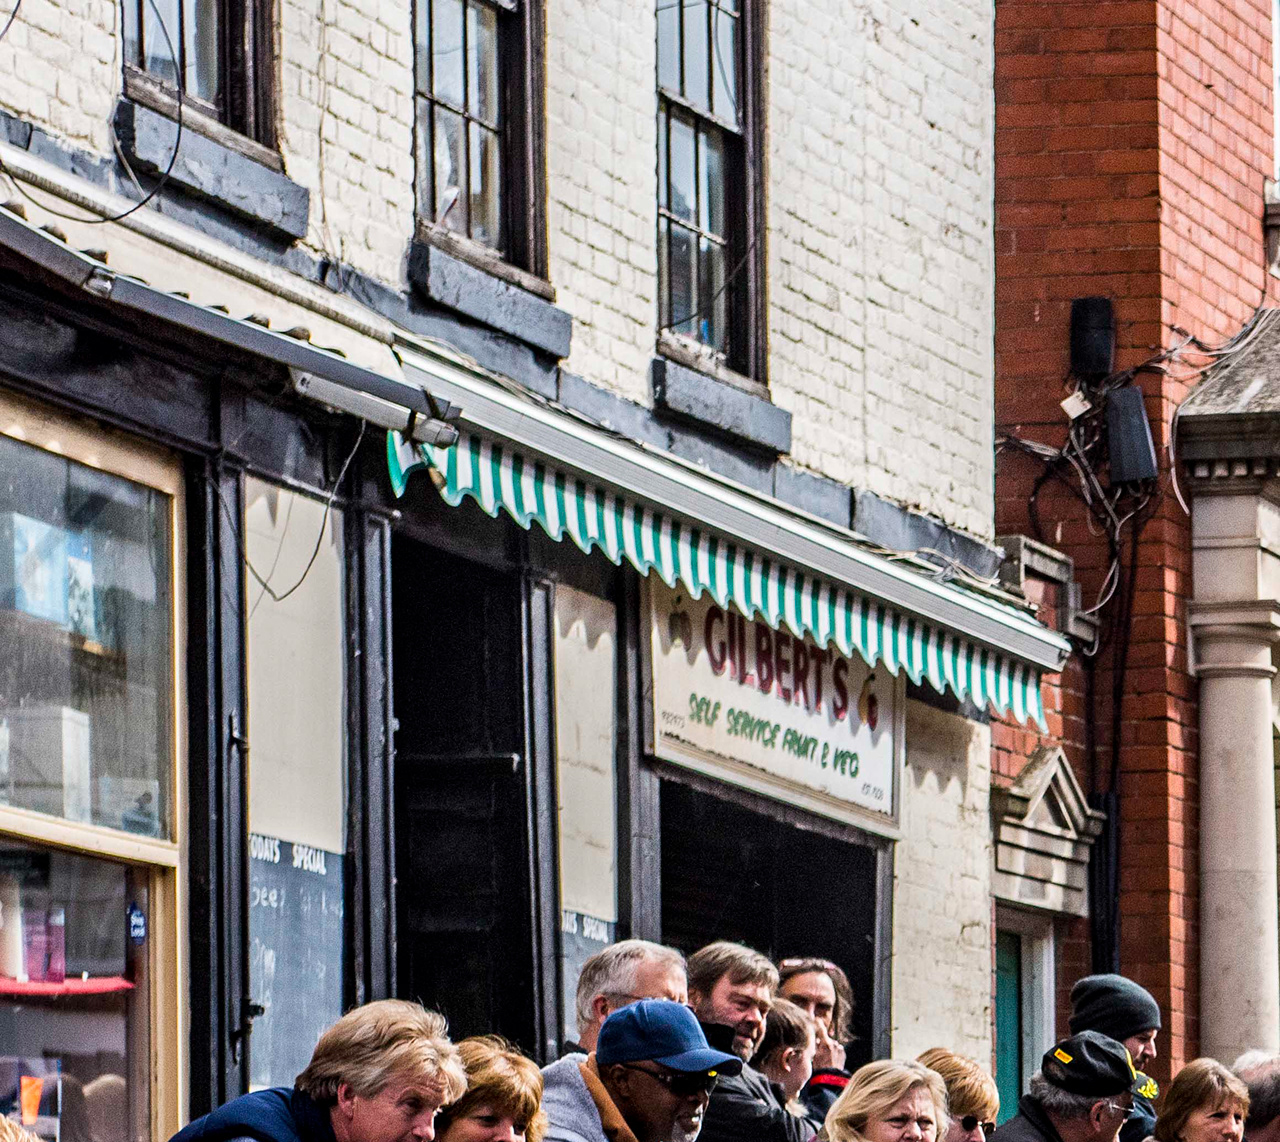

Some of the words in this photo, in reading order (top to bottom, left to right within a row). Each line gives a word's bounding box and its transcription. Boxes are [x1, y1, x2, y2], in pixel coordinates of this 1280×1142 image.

[704, 605, 849, 722] GILBERT'S
[688, 692, 721, 728] SELF
[726, 707, 781, 750] SERVICE
[782, 727, 818, 763] FRUIT
[833, 746, 860, 779] VEG
[250, 834, 281, 864] ODAYS
[292, 844, 327, 876] SPECIAL
